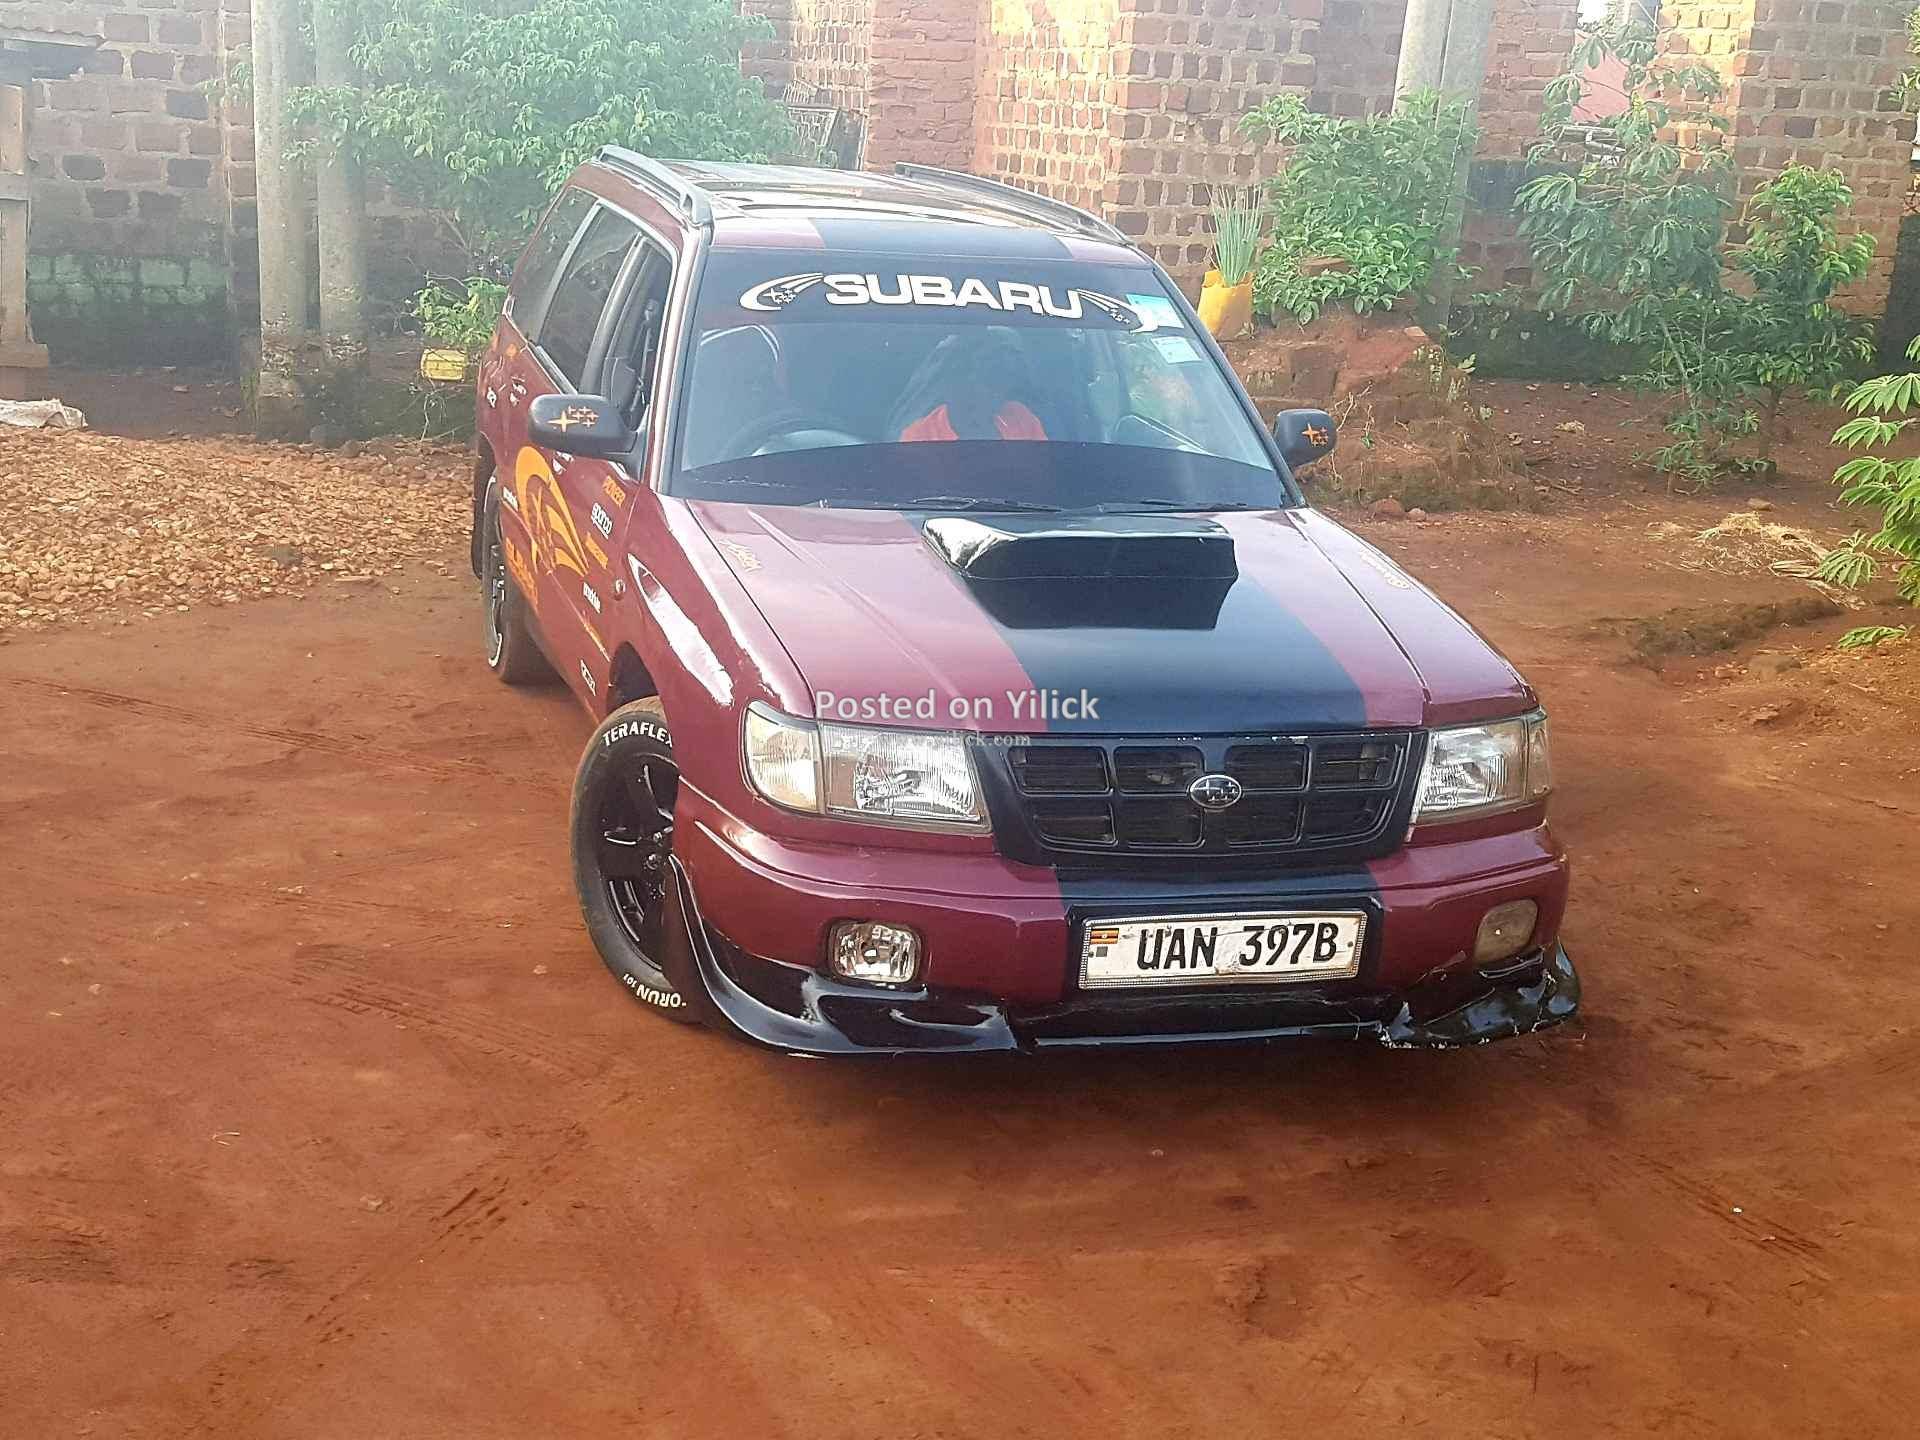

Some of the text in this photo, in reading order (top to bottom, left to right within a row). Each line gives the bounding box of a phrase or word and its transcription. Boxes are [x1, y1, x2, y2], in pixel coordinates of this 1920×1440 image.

[823, 273, 1084, 319] SUBARU
[1137, 922, 1340, 970] UAN 397B
